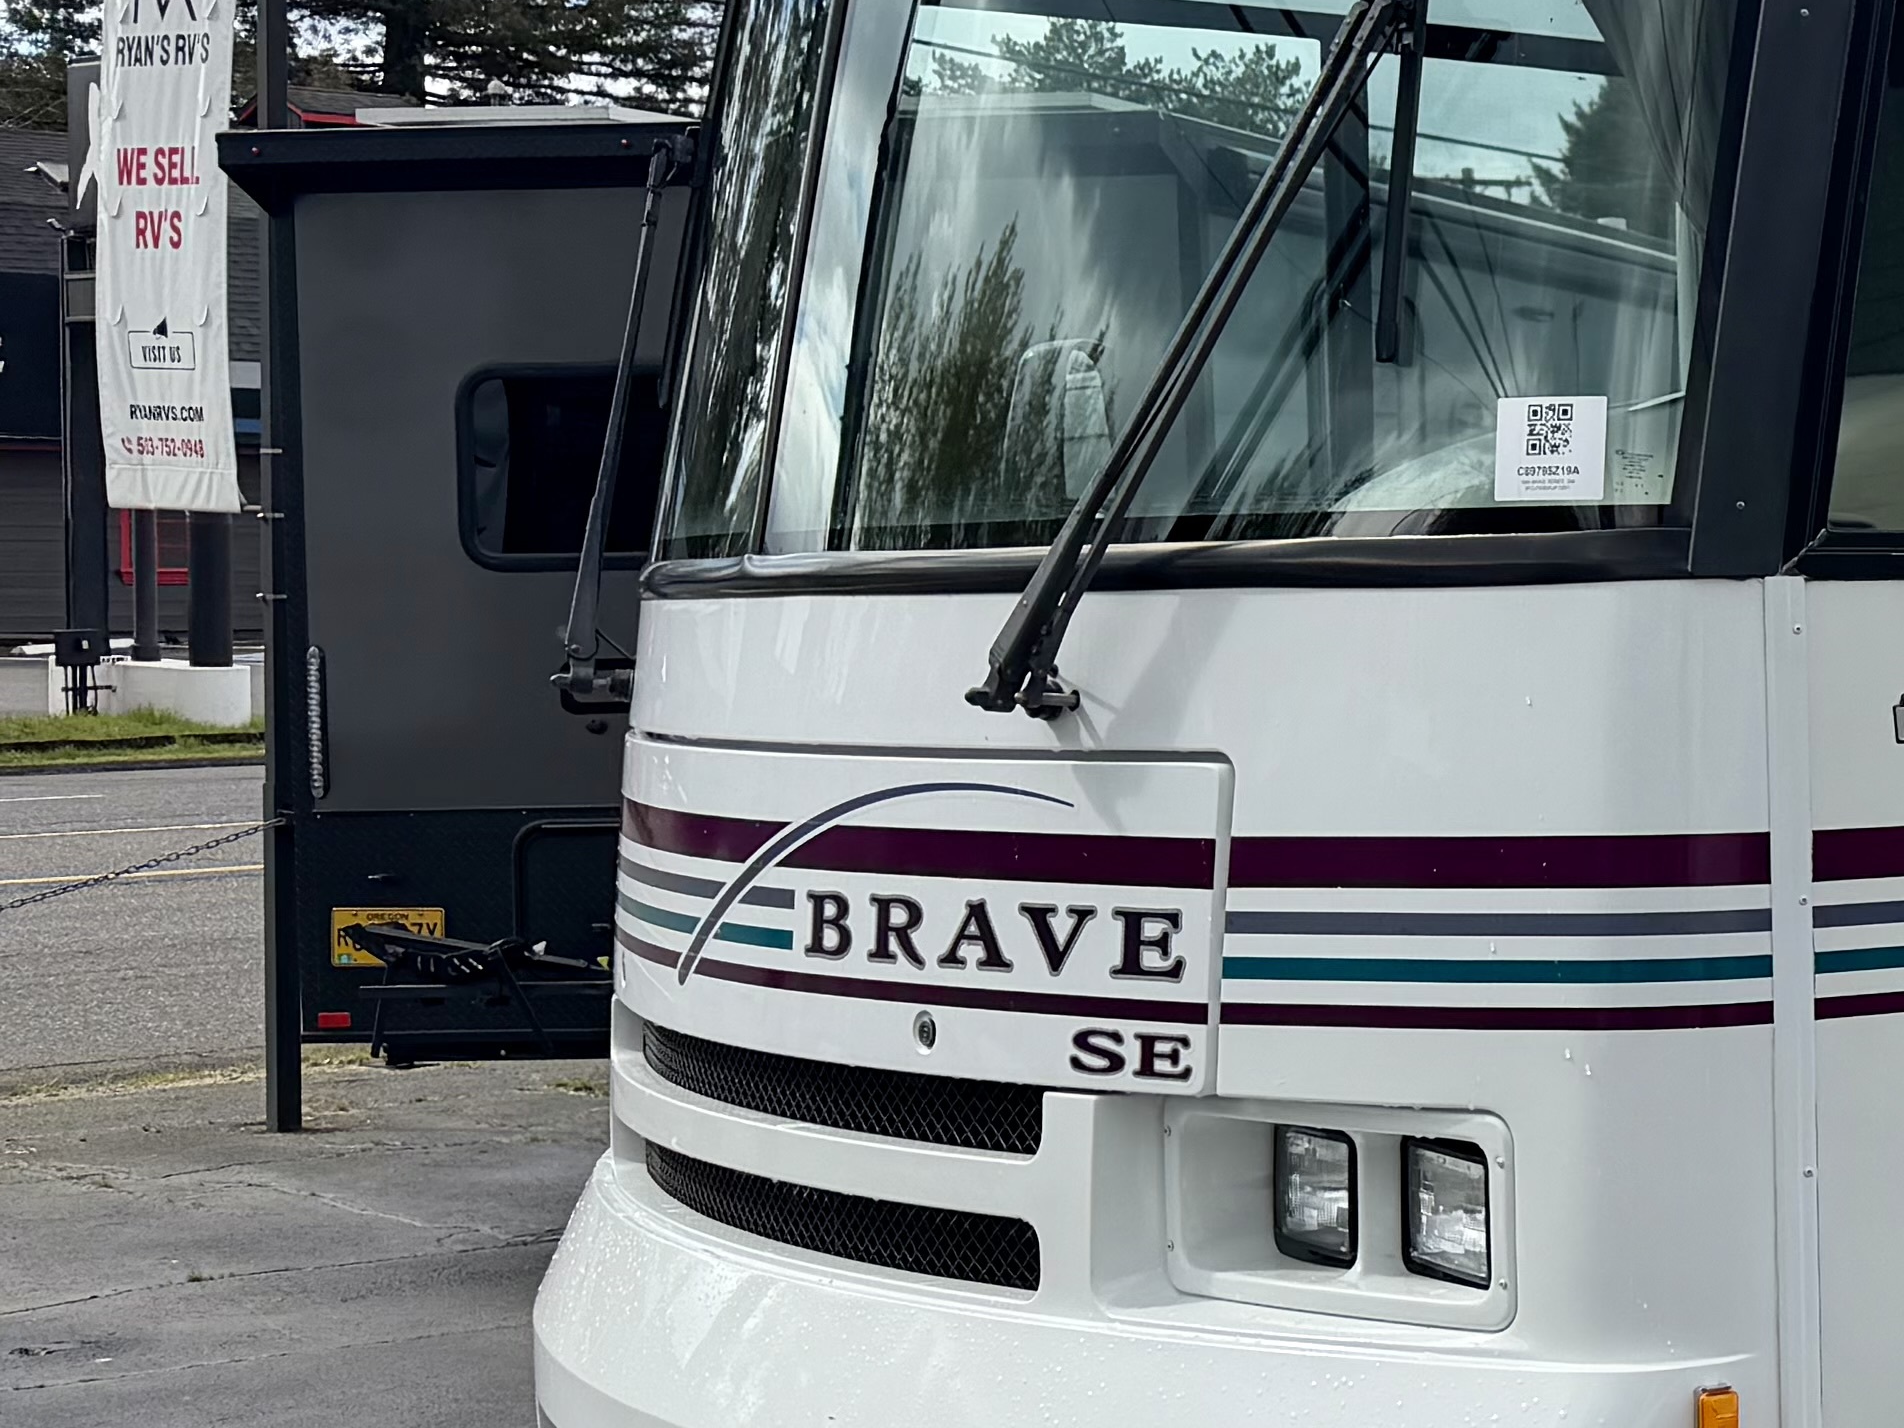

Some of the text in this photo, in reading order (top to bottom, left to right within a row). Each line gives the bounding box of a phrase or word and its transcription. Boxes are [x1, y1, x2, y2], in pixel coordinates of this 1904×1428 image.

[115, 32, 211, 67] RYAN'S RV'S
[117, 146, 200, 186] WE SELL
[135, 208, 183, 249] RV'S
[141, 345, 182, 364] VISIT US
[366, 912, 409, 921] OREGON
[804, 889, 1188, 984] BRAVE
[1069, 1027, 1193, 1083] SE
